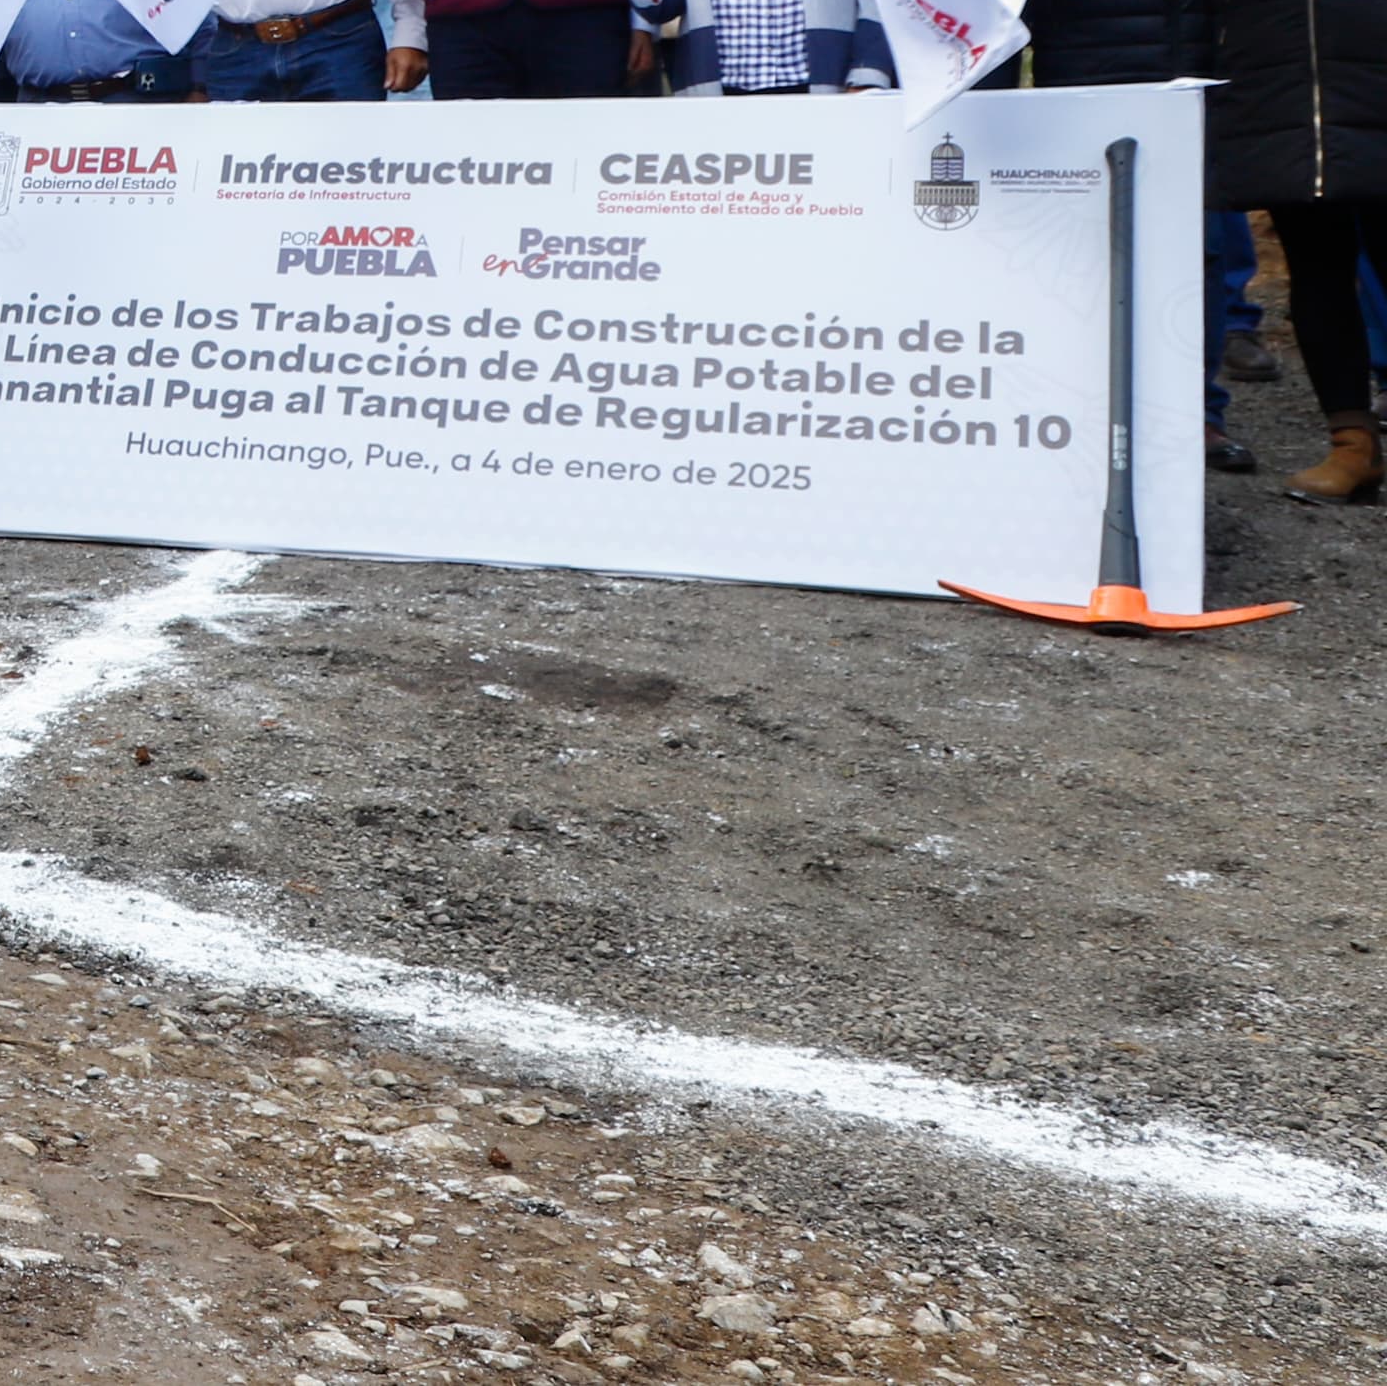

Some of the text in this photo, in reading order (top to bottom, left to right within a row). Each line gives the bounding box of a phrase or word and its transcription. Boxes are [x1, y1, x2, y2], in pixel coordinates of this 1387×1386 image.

[24, 147, 178, 174] PUEBLA
[220, 153, 553, 185] Infraestructura
[600, 153, 814, 185] CEASPUE
[990, 169, 1101, 179] HUAUCHINANGO
[21, 176, 177, 191] Gobierno del Estado
[288, 189, 305, 201] de
[309, 189, 411, 201] Infraestructura
[597, 190, 803, 205] Comisión Estatal de Agua y
[596, 202, 864, 217] Saneamiento del Estado de Puebla
[280, 226, 428, 247] POR AMOR A
[519, 227, 647, 257] Pensar
[276, 248, 438, 278] PUEBLA
[522, 253, 661, 282] Grande
[111, 299, 163, 328] de
[174, 300, 239, 330] los
[249, 301, 452, 343] Trabajos
[462, 307, 521, 339] de
[533, 309, 884, 351] Construcción
[898, 319, 965, 354] de
[979, 320, 1025, 356] la
[4, 334, 992, 400] Línea de Conducción de Agua Potable del
[163, 378, 274, 420] Puga
[285, 384, 326, 415] al
[336, 385, 511, 429] Tanque
[523, 394, 583, 426] de
[595, 396, 997, 446] Regularización
[1014, 414, 1072, 450] 10
[125, 431, 812, 491] Huauchinango, Pue., a 4 de enero de 2025
